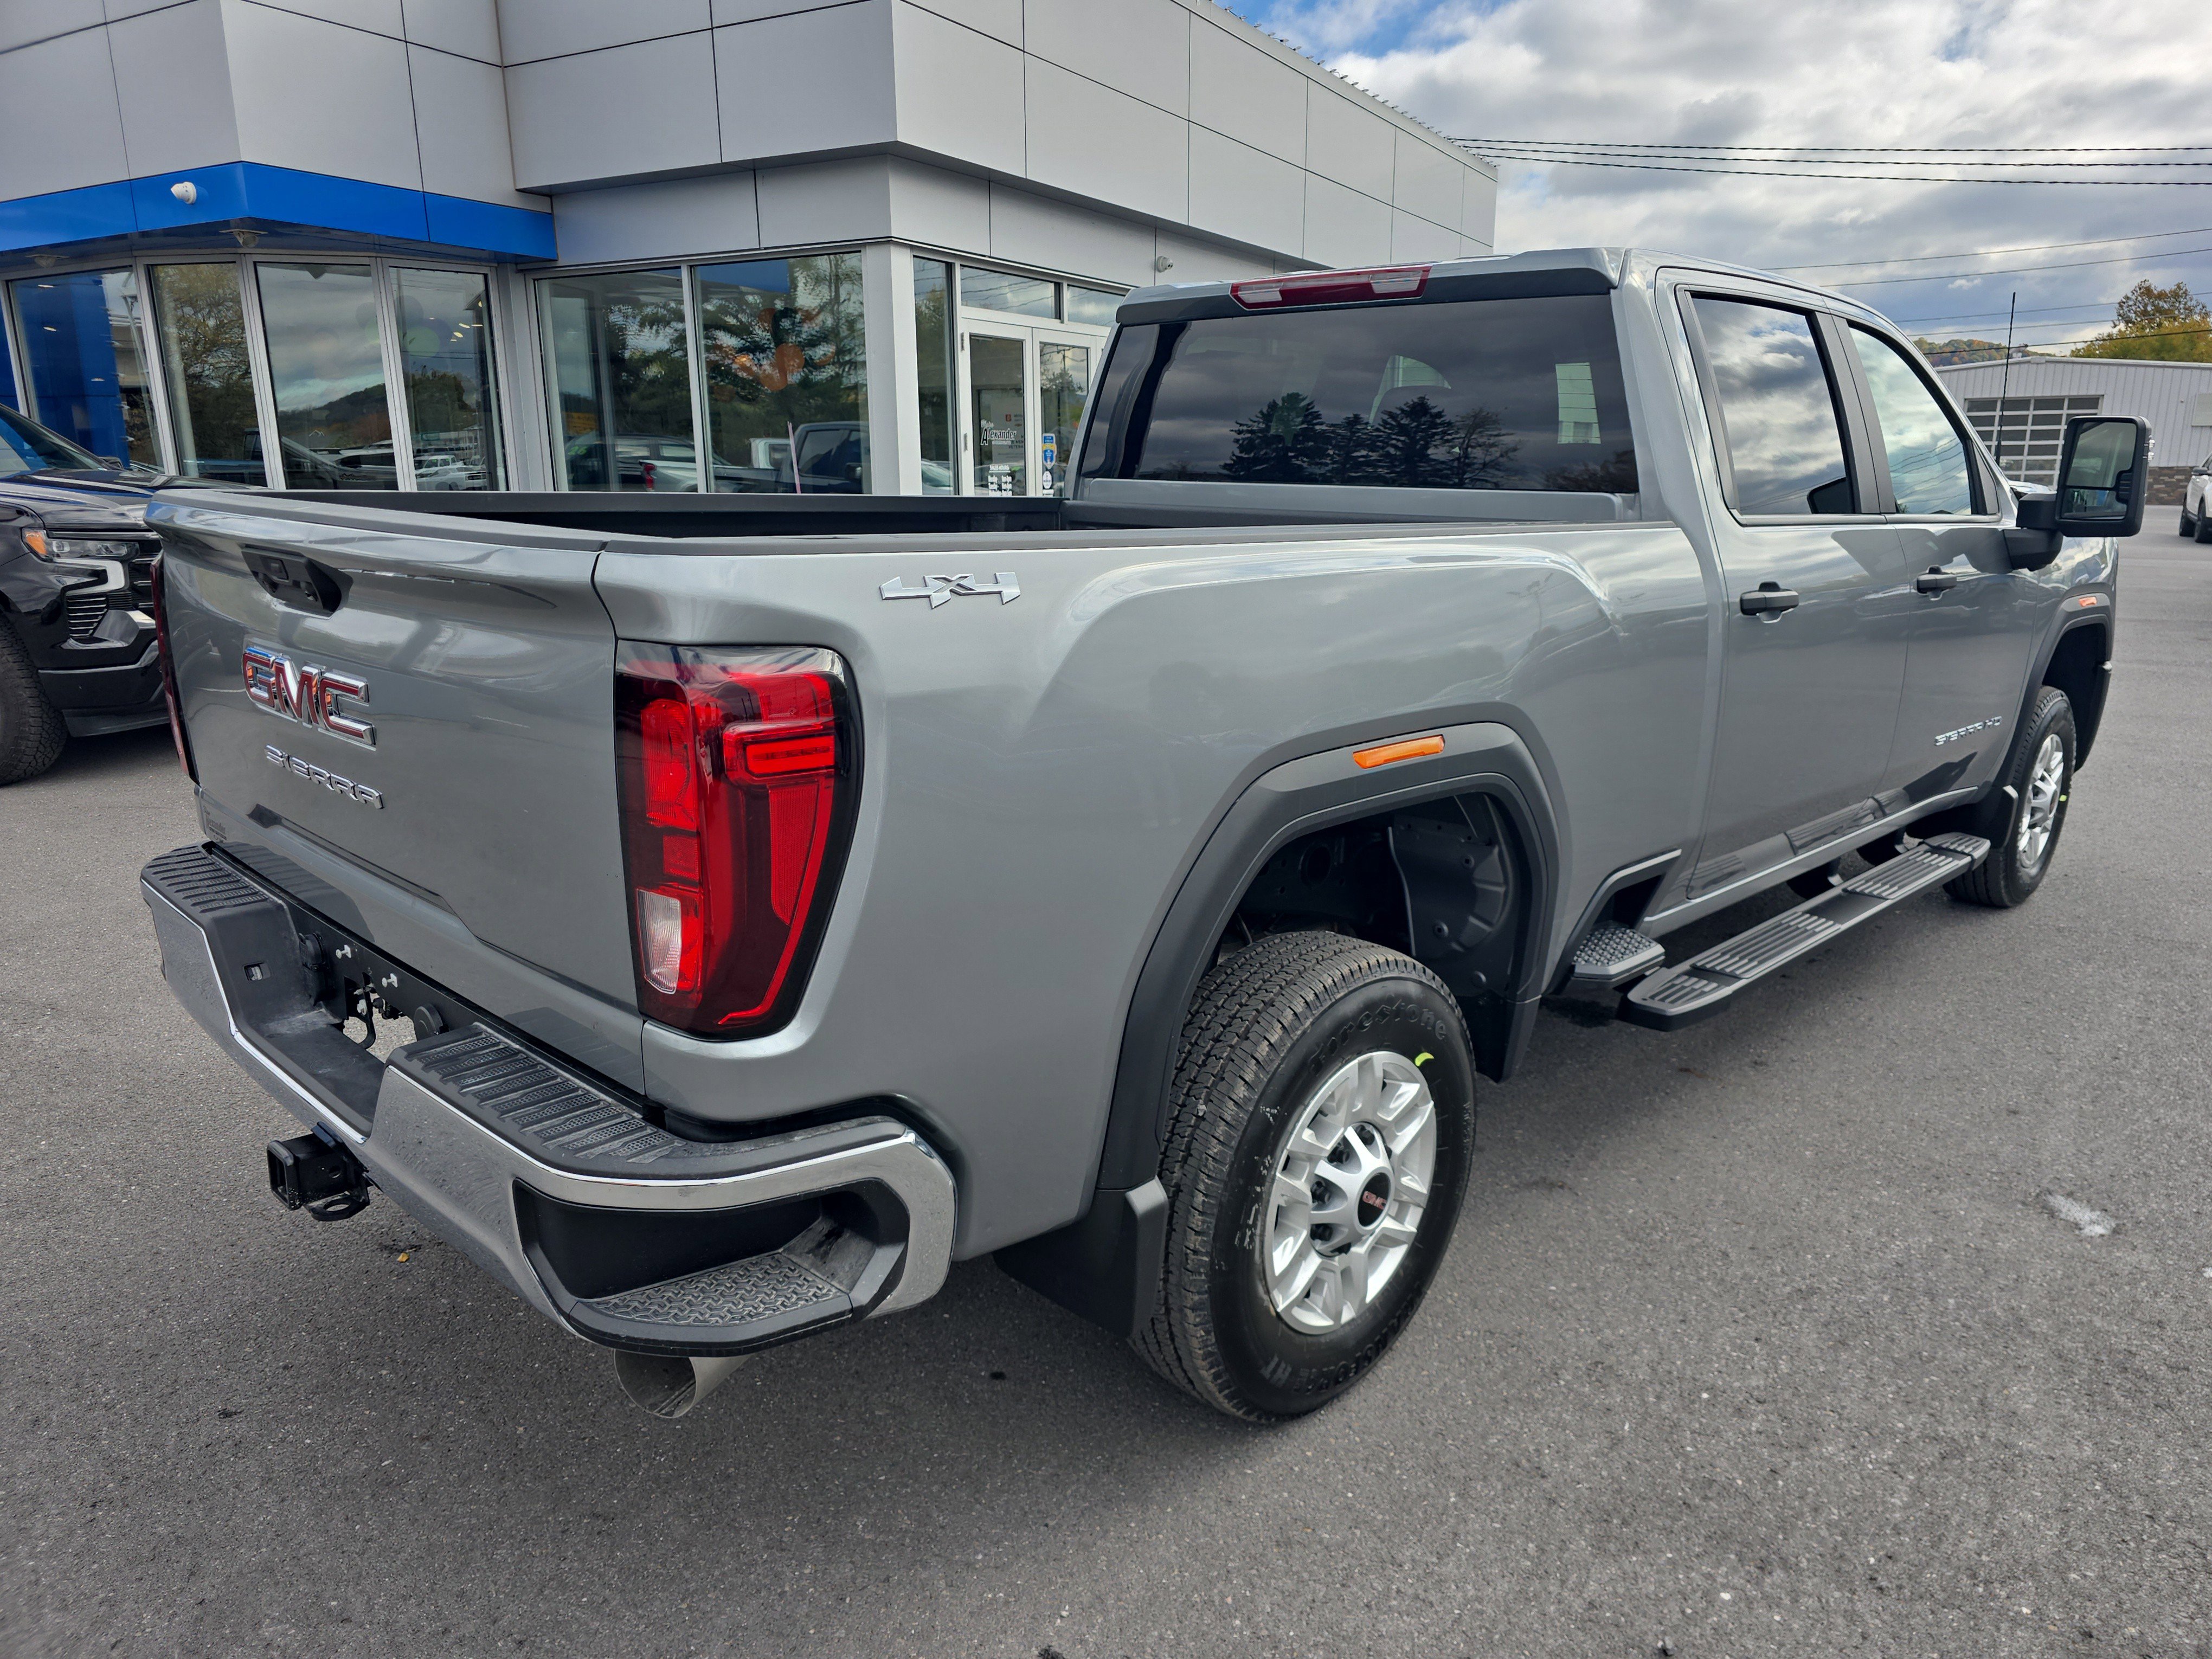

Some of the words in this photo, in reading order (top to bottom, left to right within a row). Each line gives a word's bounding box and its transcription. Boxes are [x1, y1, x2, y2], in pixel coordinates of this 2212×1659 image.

[981, 428, 1017, 445] Alexander
[243, 646, 376, 746] GMC
[265, 744, 385, 809] SIERRA
[1309, 999, 1446, 1077] Firestone
